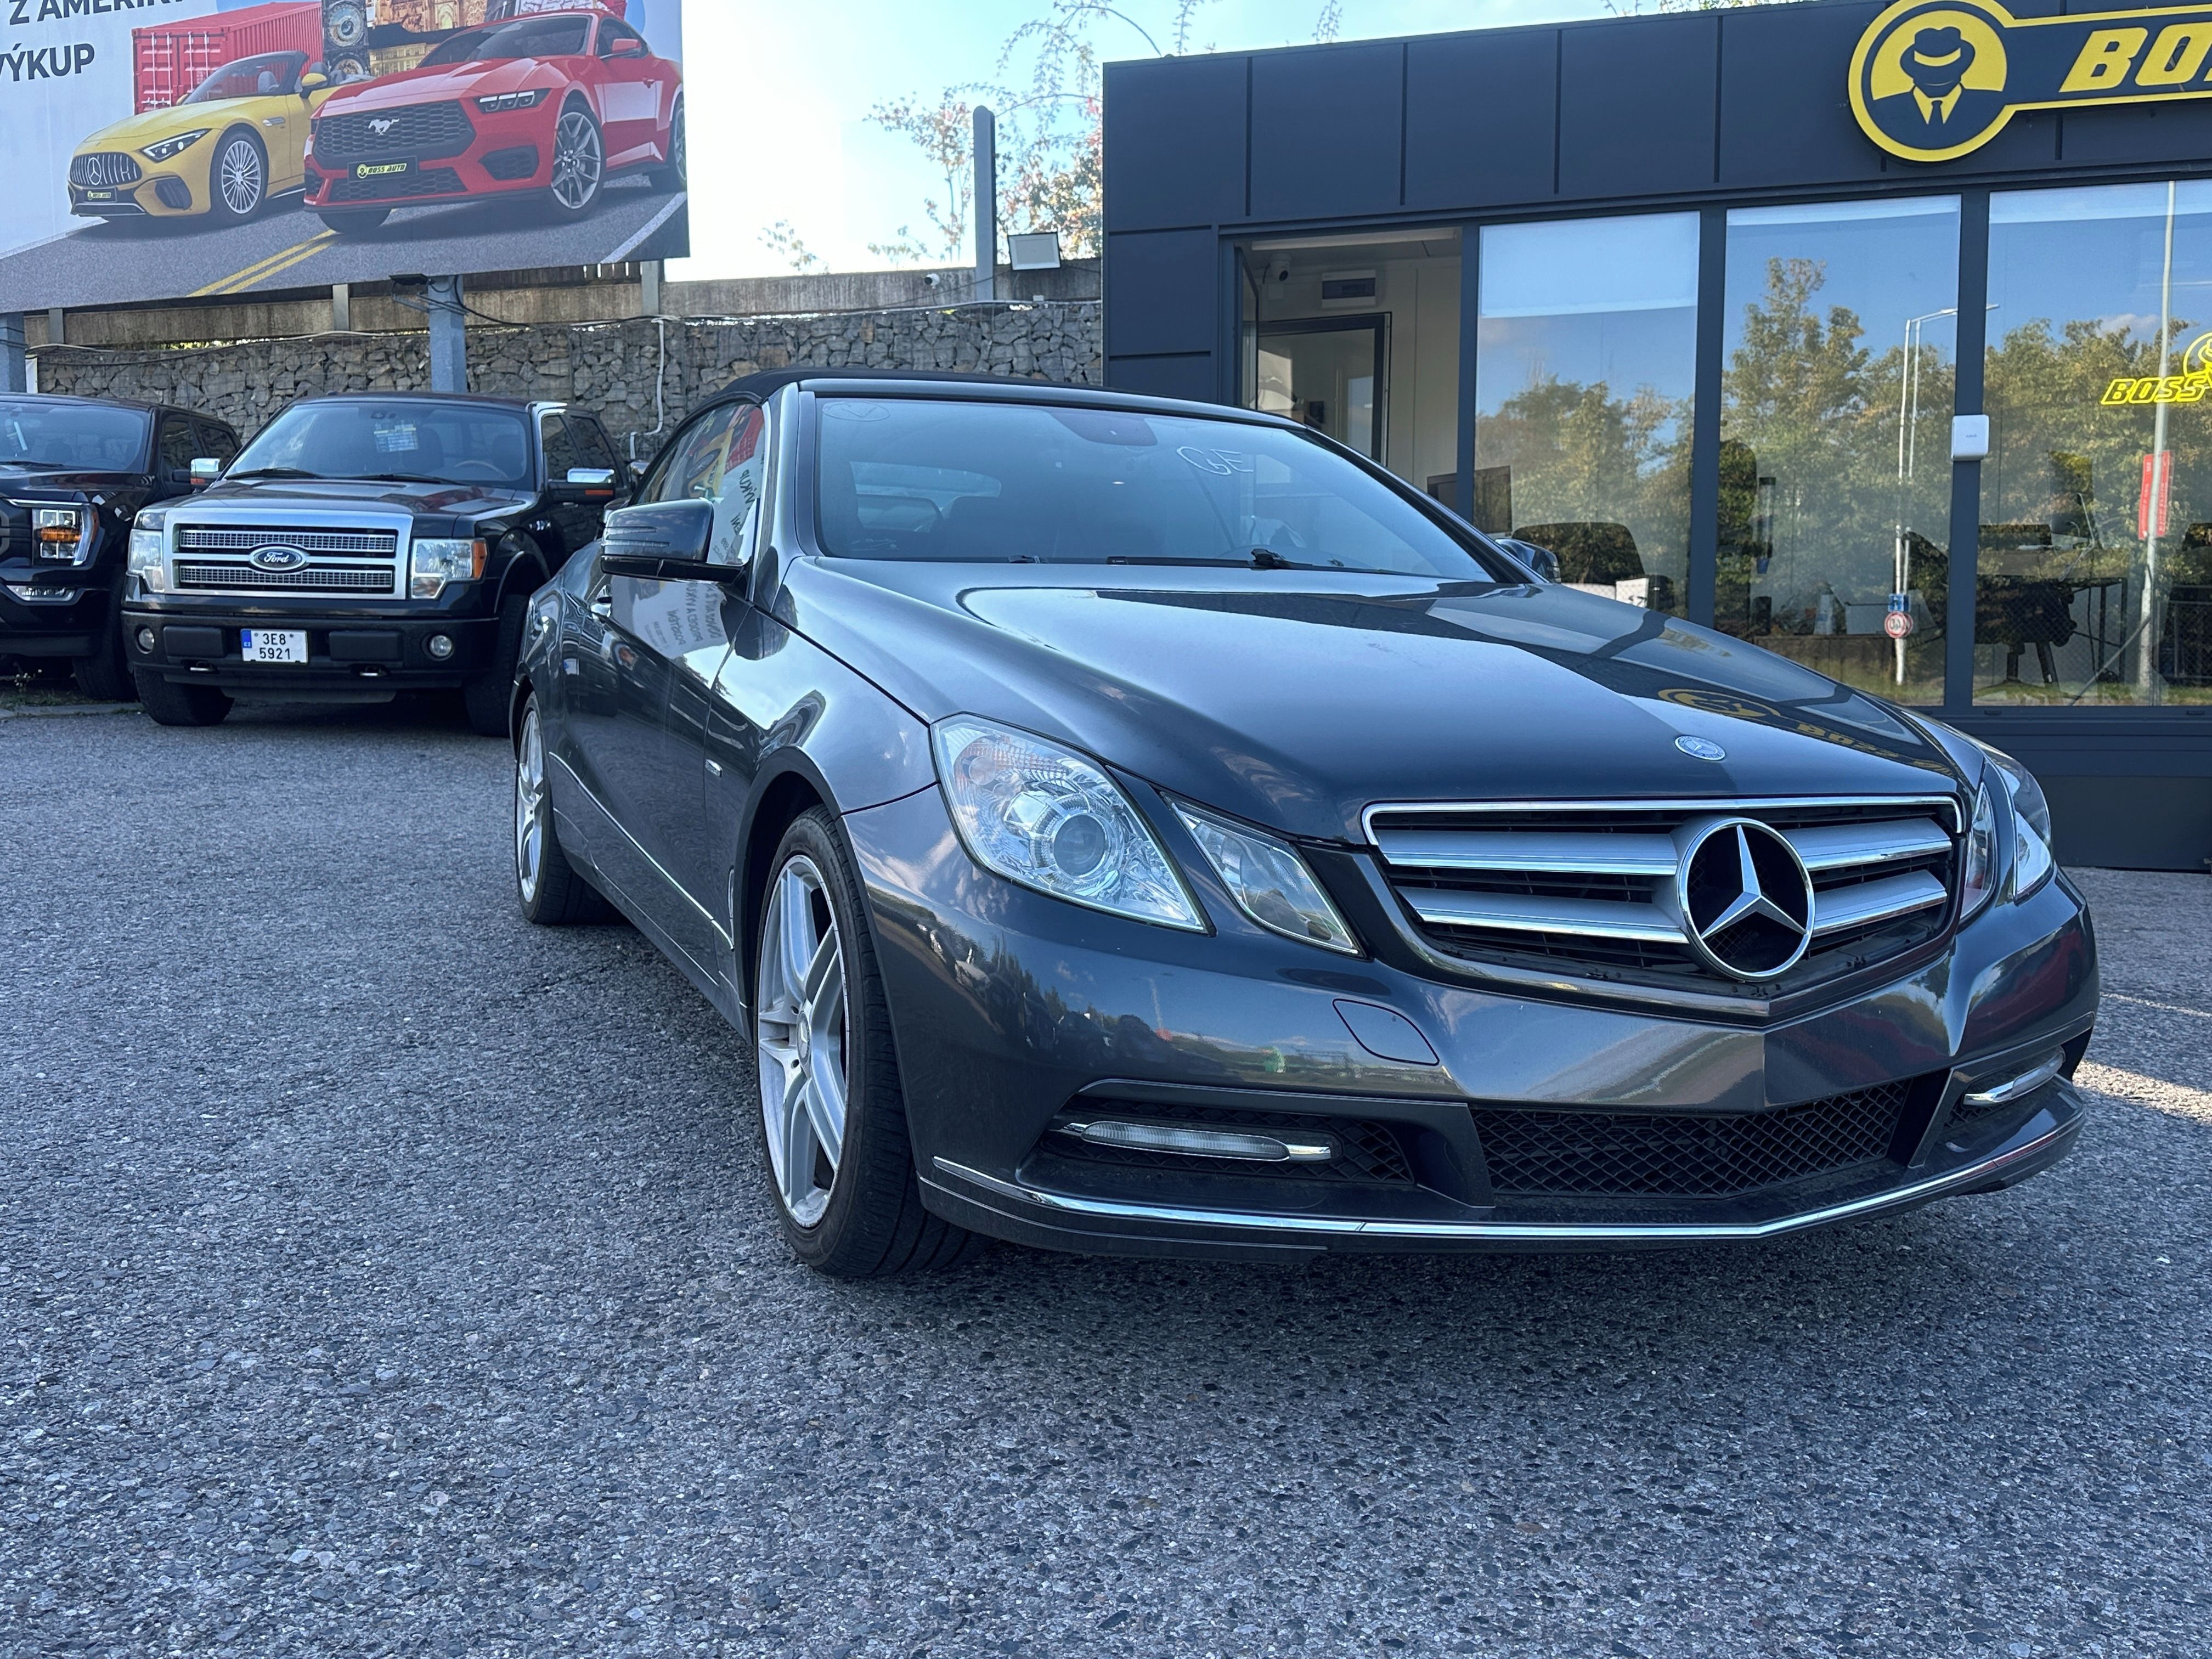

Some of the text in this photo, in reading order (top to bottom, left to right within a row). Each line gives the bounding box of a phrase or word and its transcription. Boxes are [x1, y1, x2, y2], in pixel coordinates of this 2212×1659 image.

[2058, 21, 2212, 93] BO
[2101, 375, 2208, 405] BOSS
[263, 551, 290, 563] Ford
[263, 633, 286, 645] 3E8
[259, 647, 291, 660] 5921
